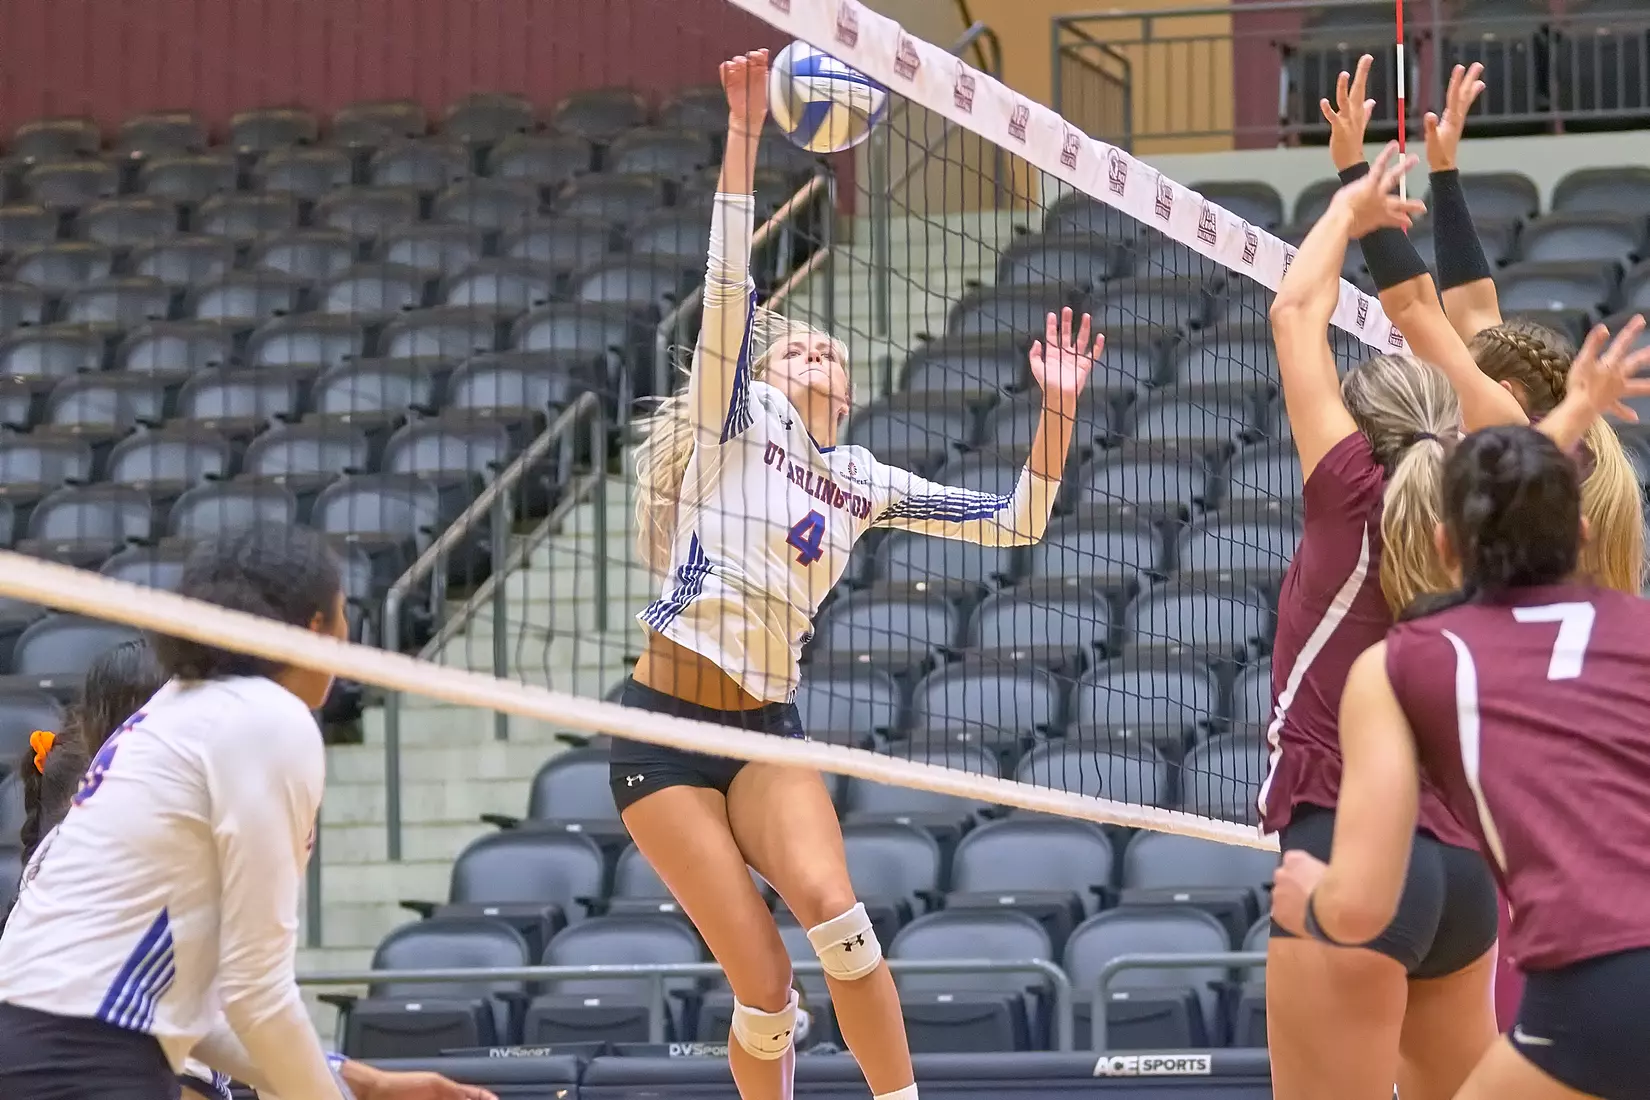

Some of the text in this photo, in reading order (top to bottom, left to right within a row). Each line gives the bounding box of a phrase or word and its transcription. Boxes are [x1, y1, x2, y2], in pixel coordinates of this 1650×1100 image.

[763, 440, 873, 521] UT ARLINGTON
[785, 509, 827, 568] 4
[1511, 601, 1596, 681] 7
[1093, 1055, 1207, 1077] ACE SPORTS
